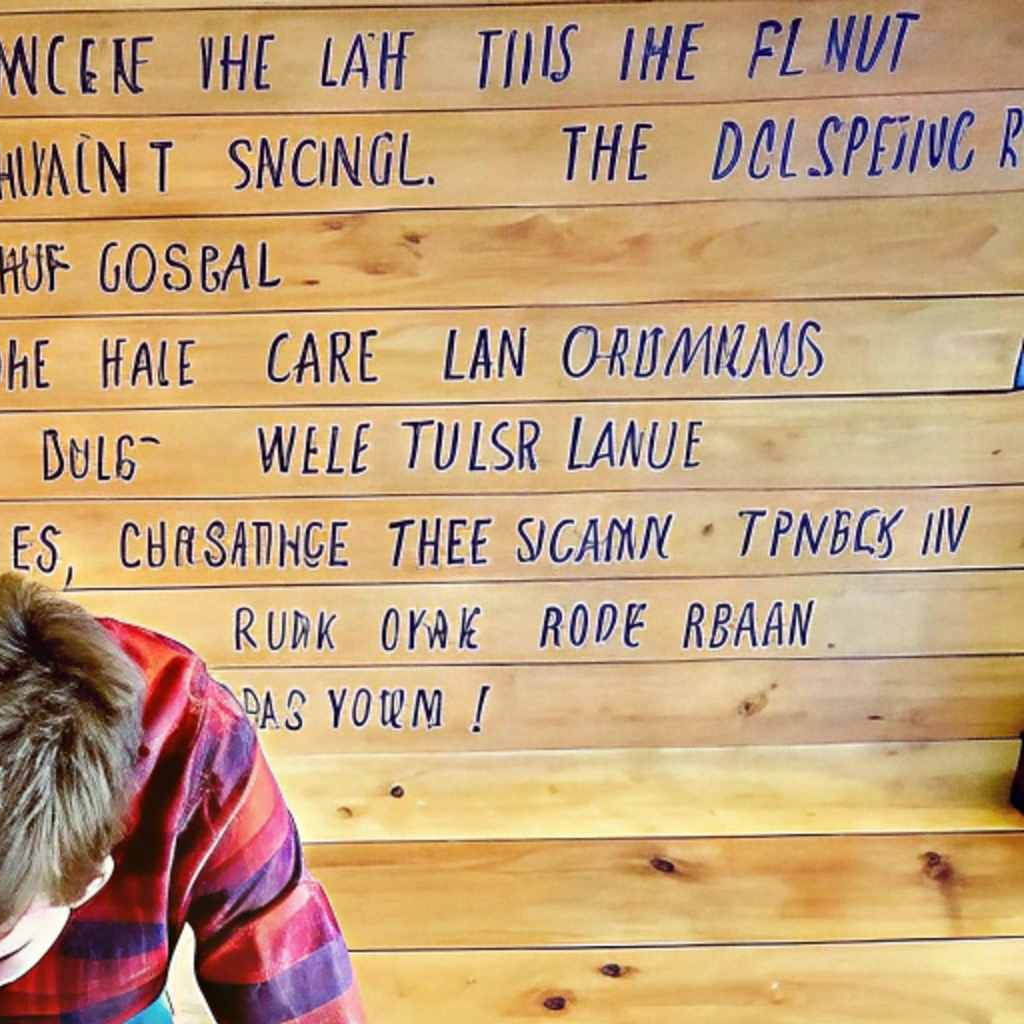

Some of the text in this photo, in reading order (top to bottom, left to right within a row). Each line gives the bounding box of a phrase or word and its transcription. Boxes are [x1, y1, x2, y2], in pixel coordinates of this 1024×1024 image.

[825, 12, 921, 73] NUT
[562, 123, 653, 181] THE
[267, 329, 378, 384] CARE
[444, 327, 527, 380] LAN
[258, 423, 370, 474] WELE
[401, 419, 540, 471] TULSR
[388, 518, 492, 567] THEE
